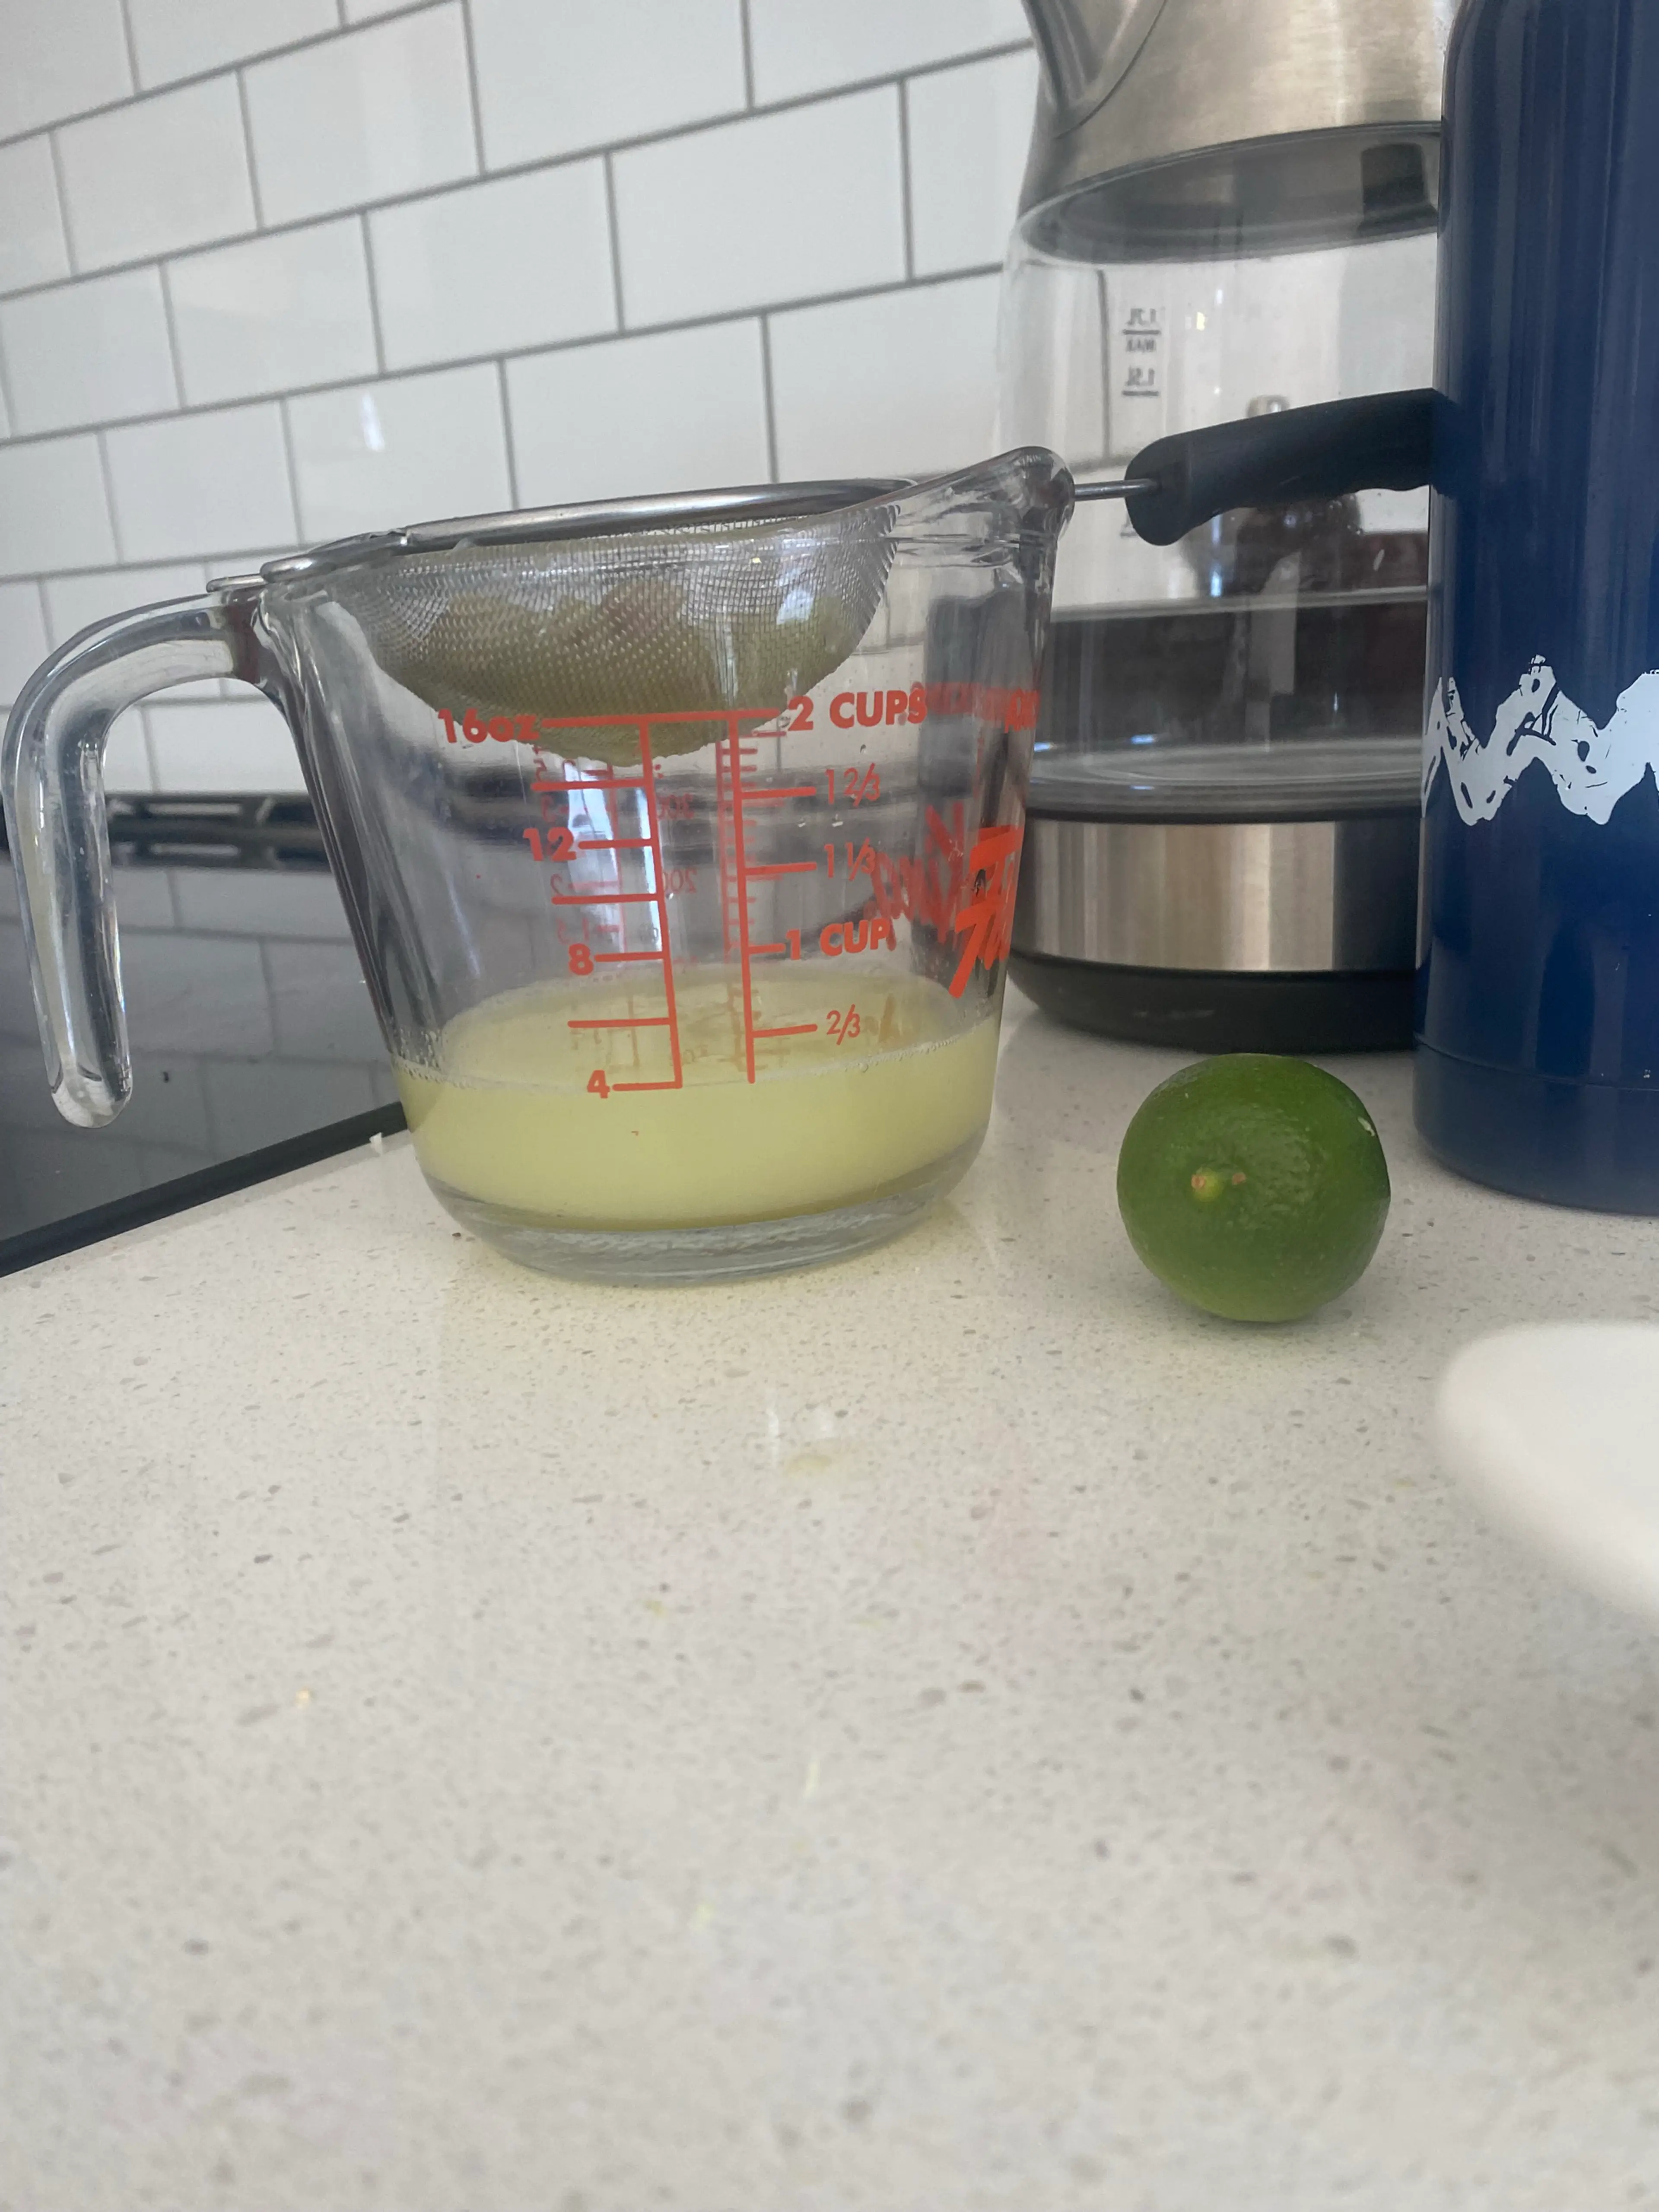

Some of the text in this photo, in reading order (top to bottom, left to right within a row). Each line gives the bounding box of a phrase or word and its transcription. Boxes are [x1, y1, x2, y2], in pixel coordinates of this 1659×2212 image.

[788, 696, 814, 731] 2
[830, 690, 928, 729] CUPS
[523, 827, 576, 861] 12
[785, 918, 890, 960] 1 CUP
[568, 943, 593, 975] 8
[826, 1004, 861, 1045] 2/3
[586, 1069, 611, 1099] 4
